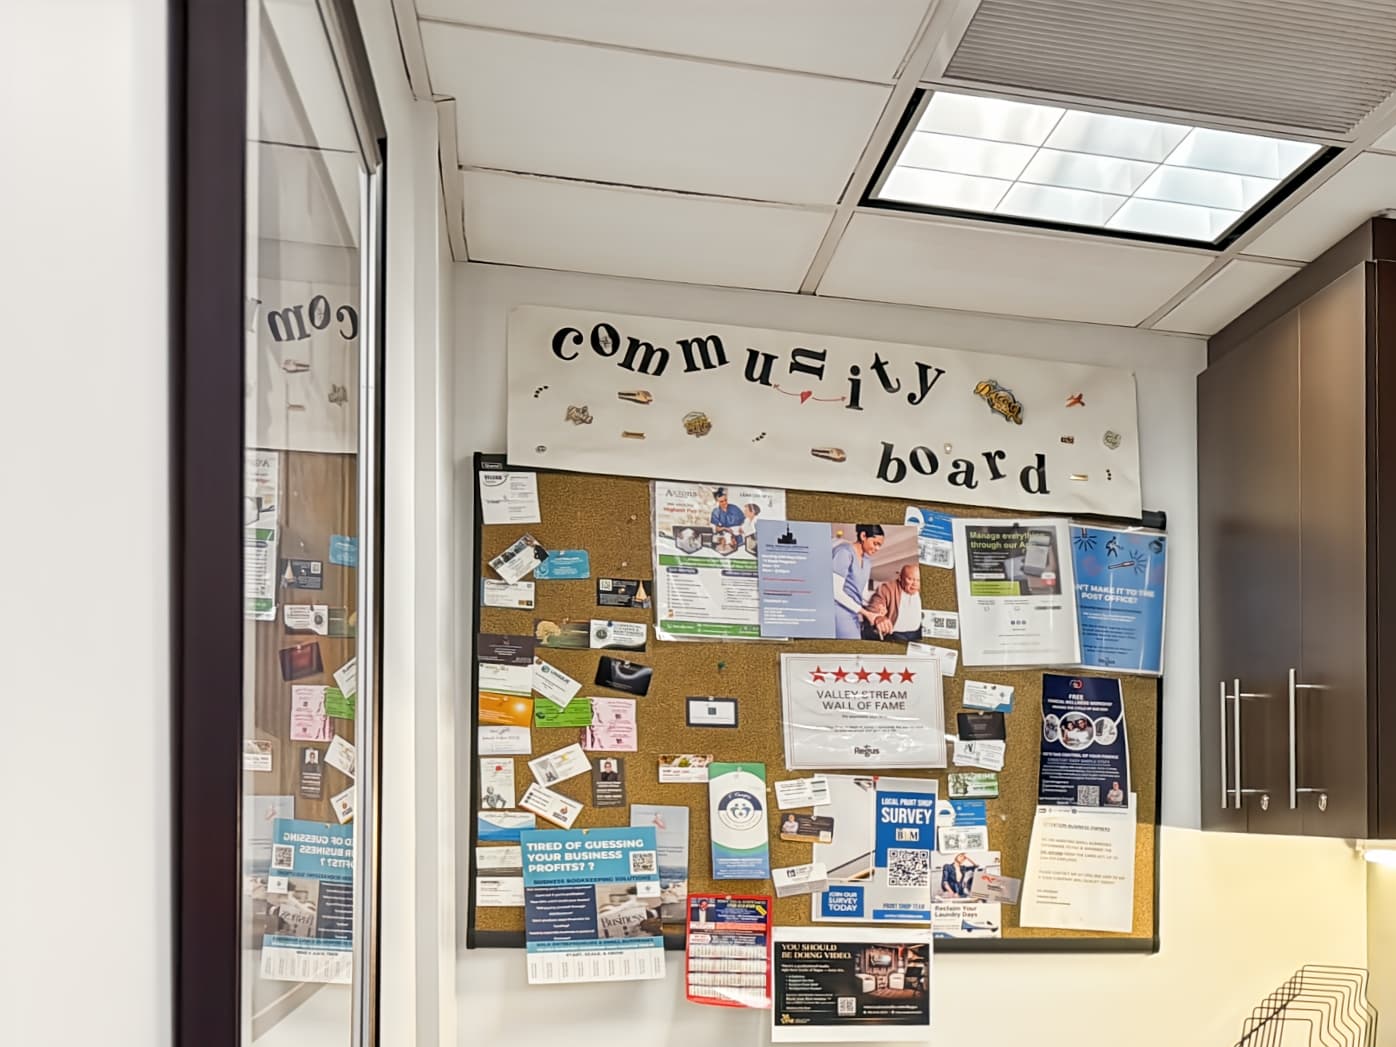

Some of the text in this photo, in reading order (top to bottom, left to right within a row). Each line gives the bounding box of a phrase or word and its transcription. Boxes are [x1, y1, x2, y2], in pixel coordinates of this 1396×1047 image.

[551, 322, 946, 411] community
[876, 441, 1051, 495] board
[969, 531, 1001, 541] Manage
[970, 541, 1002, 550] through
[1081, 592, 1103, 600] POST
[816, 690, 859, 699] VALLEY
[822, 701, 906, 711] WALL OF FAME
[881, 807, 932, 825] SURVEY
[526, 839, 644, 851] TIRED OF GUESSING
[527, 851, 623, 862] YOUR BUSINESS
[528, 862, 585, 873] PROFITS?
